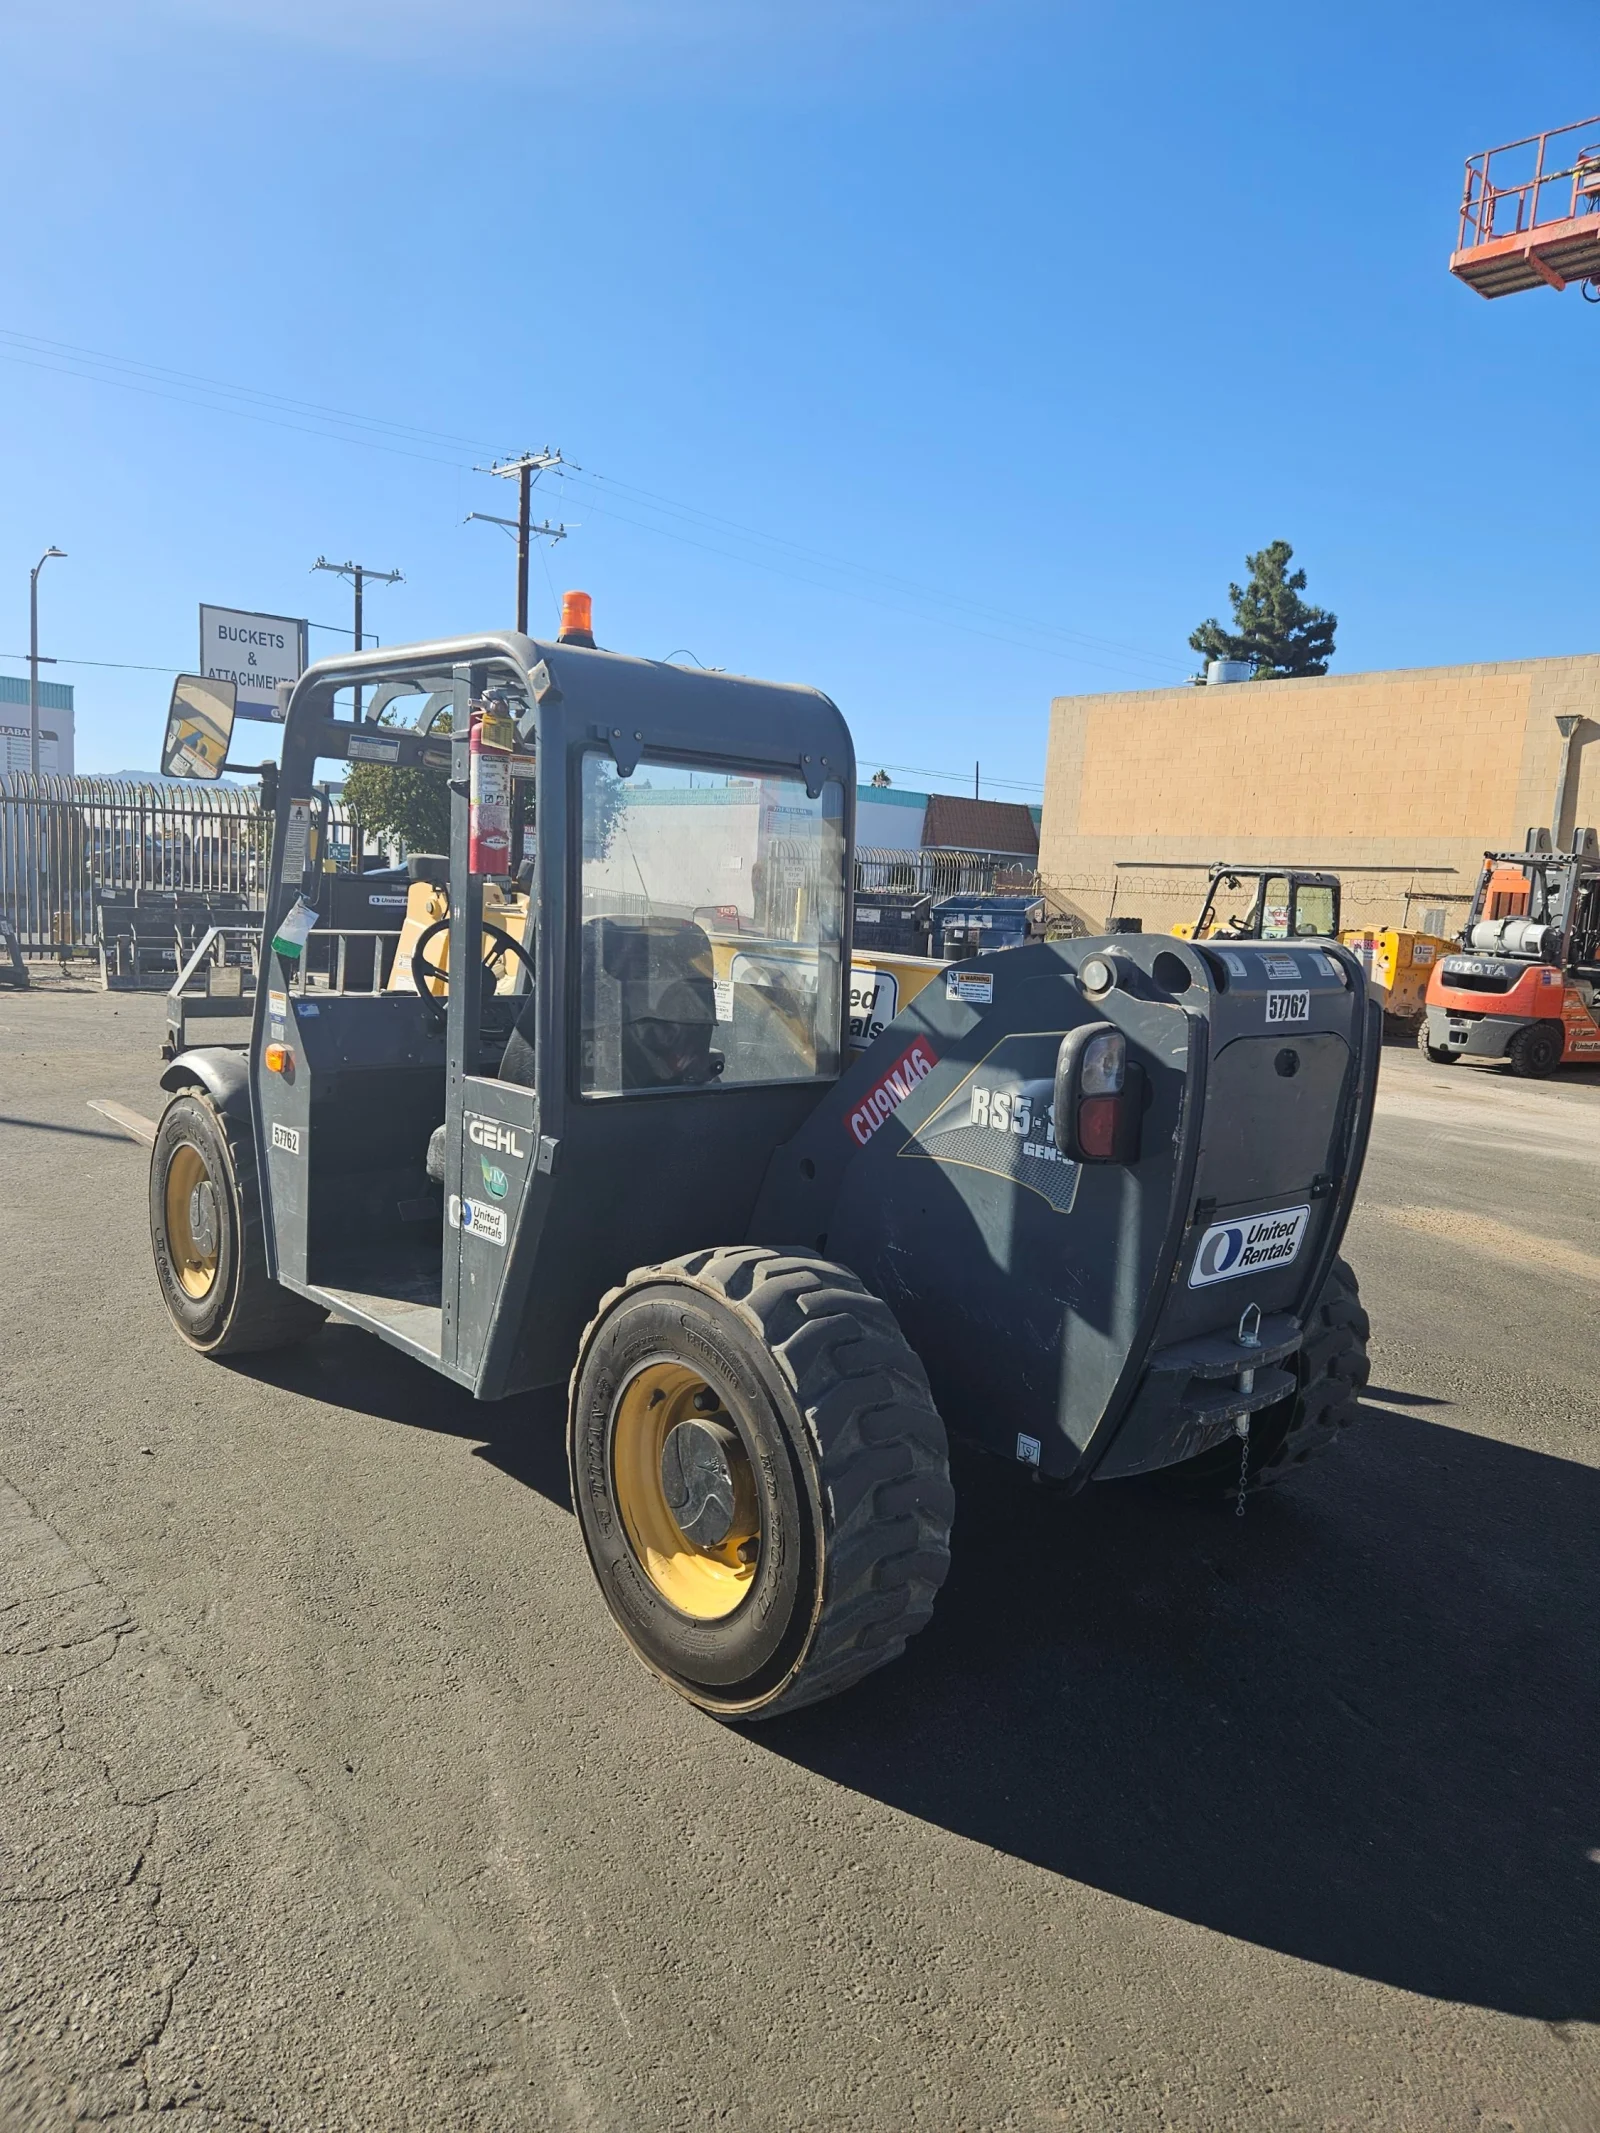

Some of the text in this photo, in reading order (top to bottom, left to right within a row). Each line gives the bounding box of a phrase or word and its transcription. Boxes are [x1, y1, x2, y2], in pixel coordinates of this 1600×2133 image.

[218, 625, 285, 649] BUCKETS
[247, 651, 258, 666] &
[0, 727, 44, 739] LABAA
[965, 975, 990, 983] WARNING
[1449, 959, 1507, 976] TOYOTA
[1269, 994, 1307, 1020] 57762
[851, 1048, 933, 1145] CU9M46
[274, 1126, 297, 1151] 57762
[469, 1121, 525, 1159] GEHL
[473, 1206, 500, 1226] United
[472, 1218, 502, 1240] Rentals
[1246, 1216, 1300, 1245] United
[1238, 1238, 1295, 1267] Rentals
